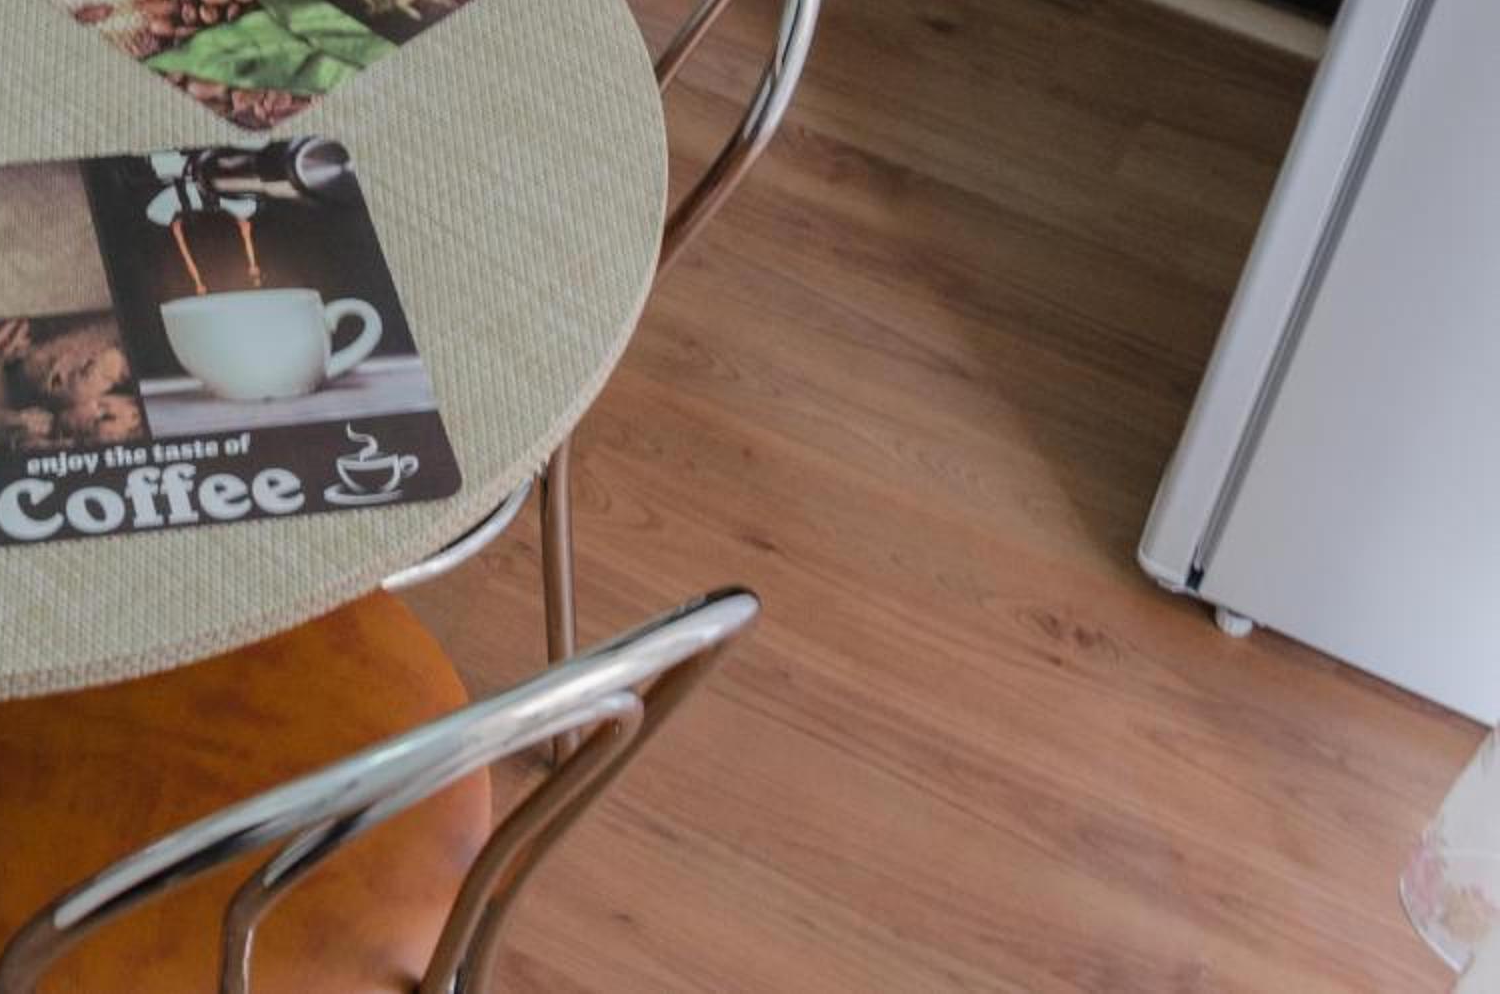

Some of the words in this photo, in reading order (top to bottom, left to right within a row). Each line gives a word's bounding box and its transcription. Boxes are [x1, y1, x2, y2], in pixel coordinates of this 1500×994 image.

[27, 452, 98, 477] enjoy
[105, 445, 147, 468] the
[153, 439, 219, 463] taste
[224, 432, 250, 455] of
